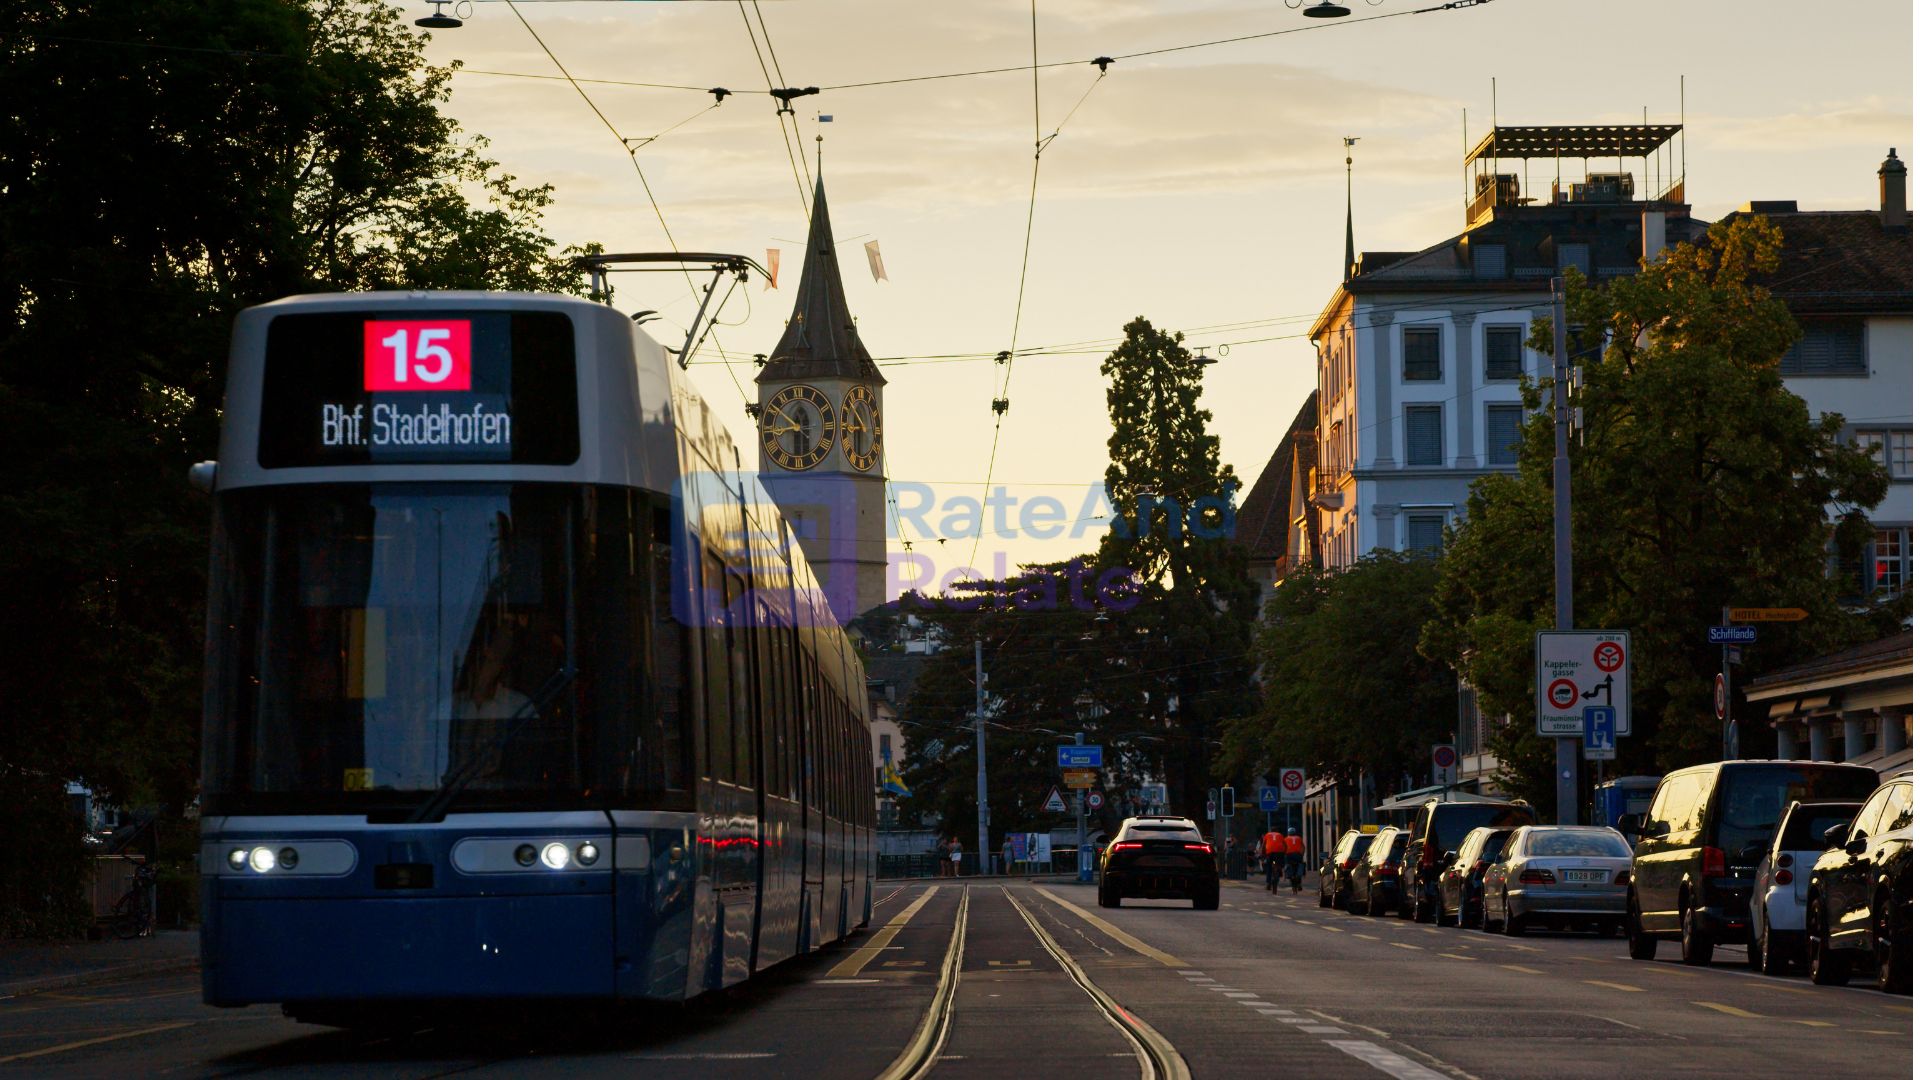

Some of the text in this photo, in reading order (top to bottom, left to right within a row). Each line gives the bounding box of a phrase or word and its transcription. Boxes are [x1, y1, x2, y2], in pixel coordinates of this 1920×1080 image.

[382, 329, 453, 383] 15
[323, 402, 511, 446] Bhf. Stadelhofen
[1544, 660, 1582, 669] Kappeler-
[1552, 669, 1574, 678] gasse
